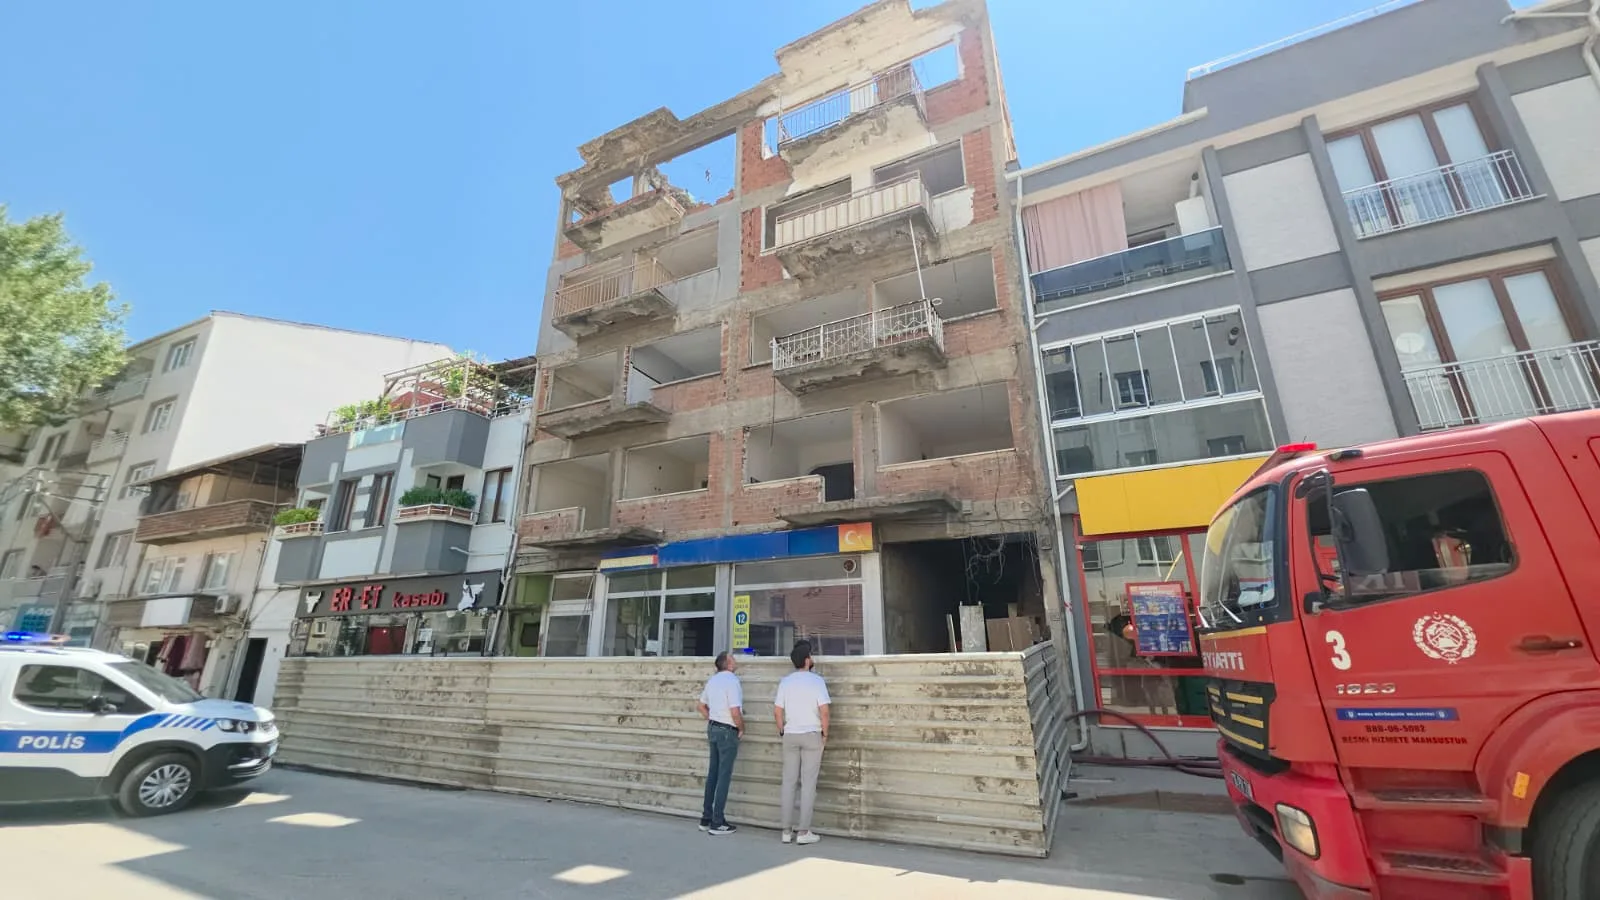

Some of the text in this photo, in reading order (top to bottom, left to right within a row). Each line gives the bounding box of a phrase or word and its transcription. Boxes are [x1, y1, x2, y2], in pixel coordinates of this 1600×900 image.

[1325, 630, 1352, 671] 3
[1335, 682, 1396, 695] 1823
[17, 732, 86, 750] POLİS
